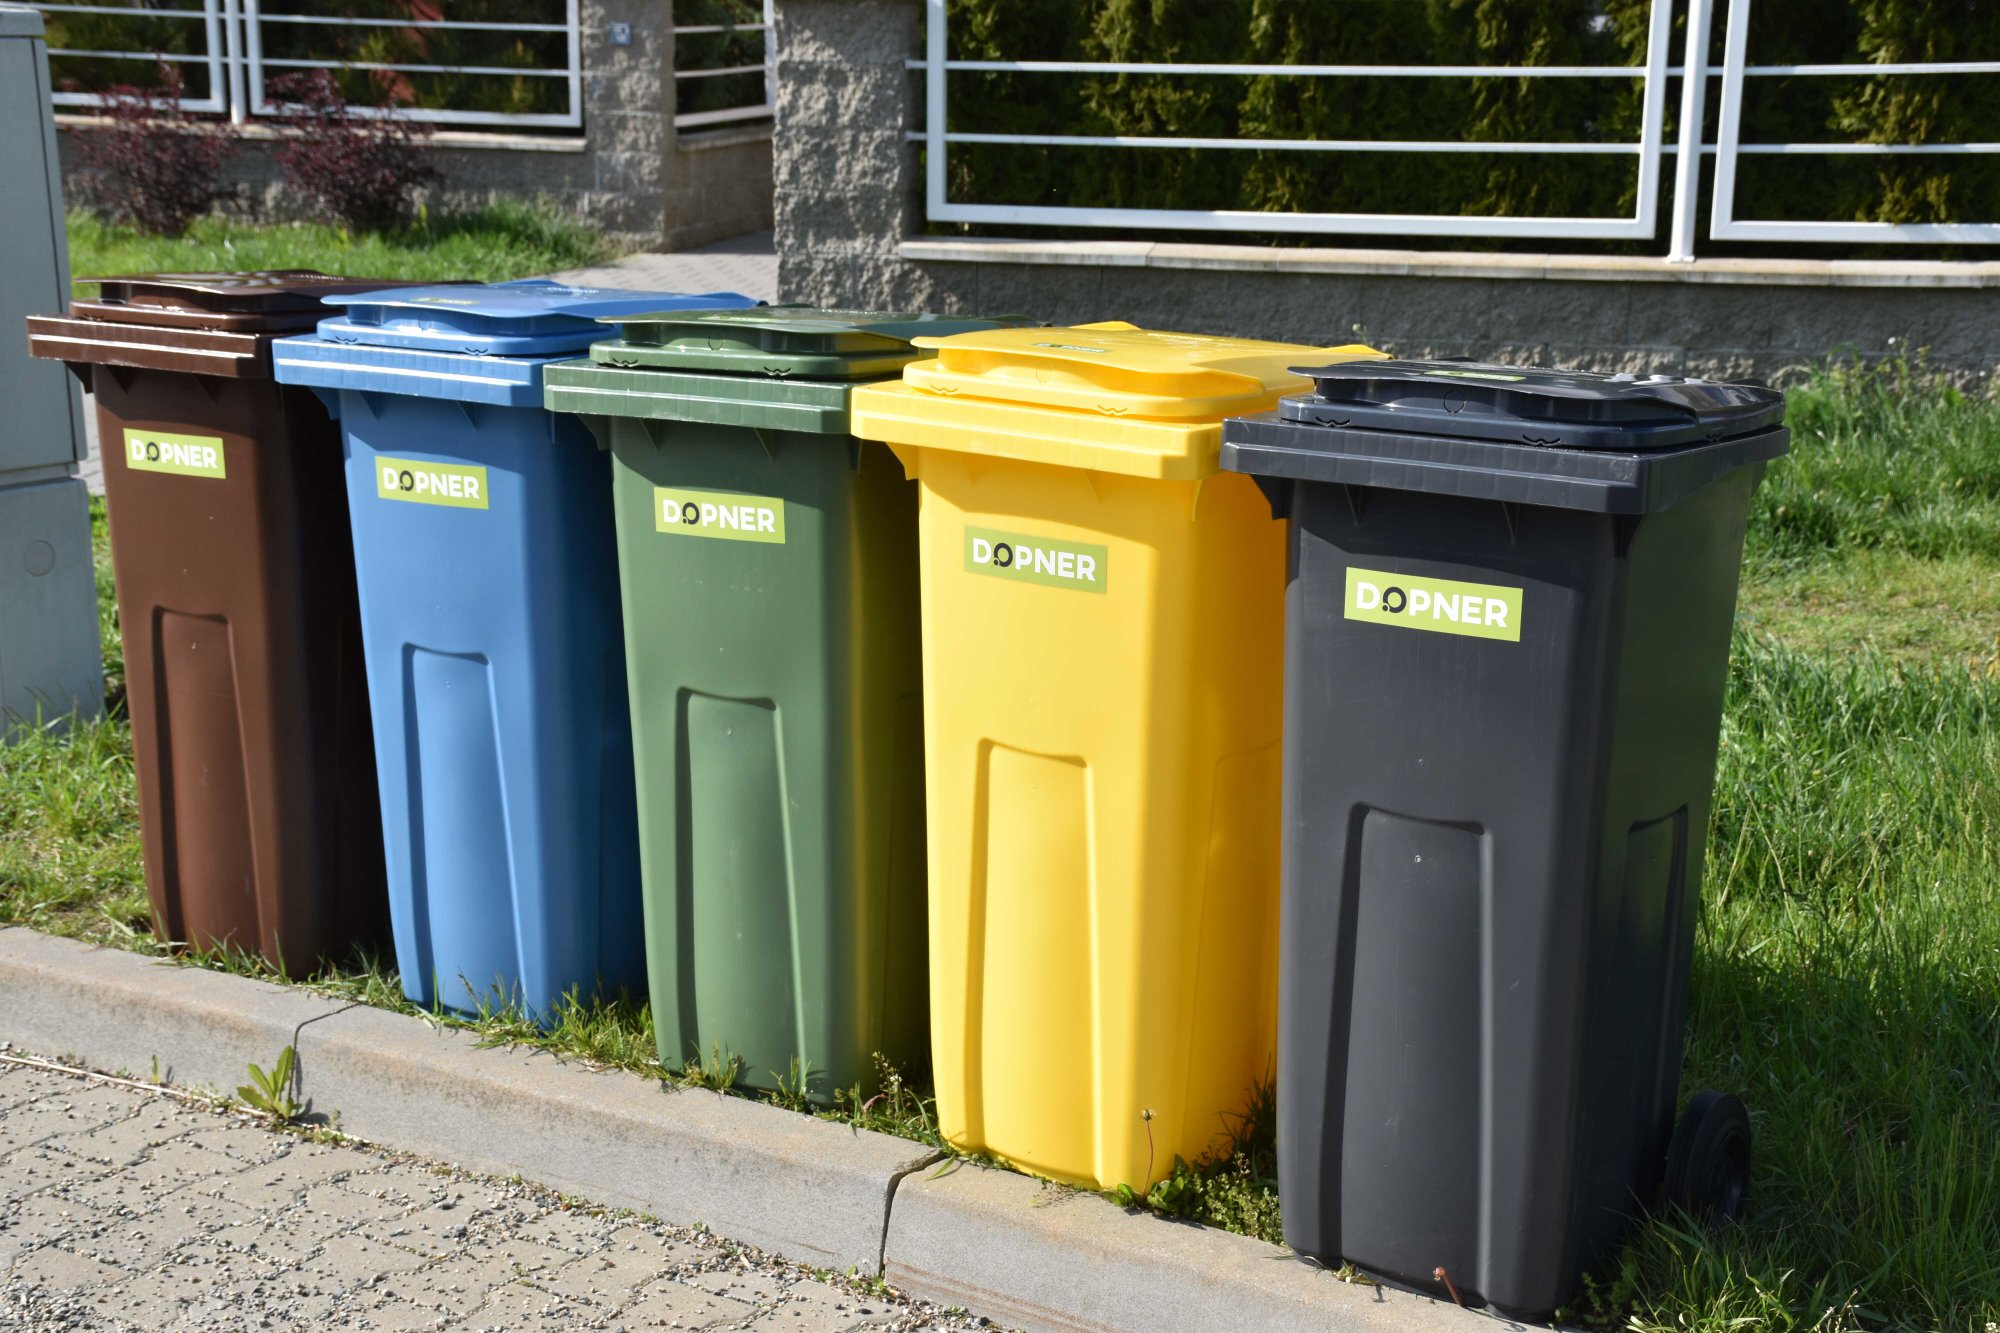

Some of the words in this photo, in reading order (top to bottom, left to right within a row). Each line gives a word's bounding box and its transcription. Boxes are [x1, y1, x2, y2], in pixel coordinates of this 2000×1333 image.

[130, 438, 218, 469] DOPNER
[382, 466, 480, 499] DOPNER
[662, 498, 776, 533] DOPNER
[972, 537, 1097, 582] DOPNER
[1355, 581, 1509, 628] DOPNER
